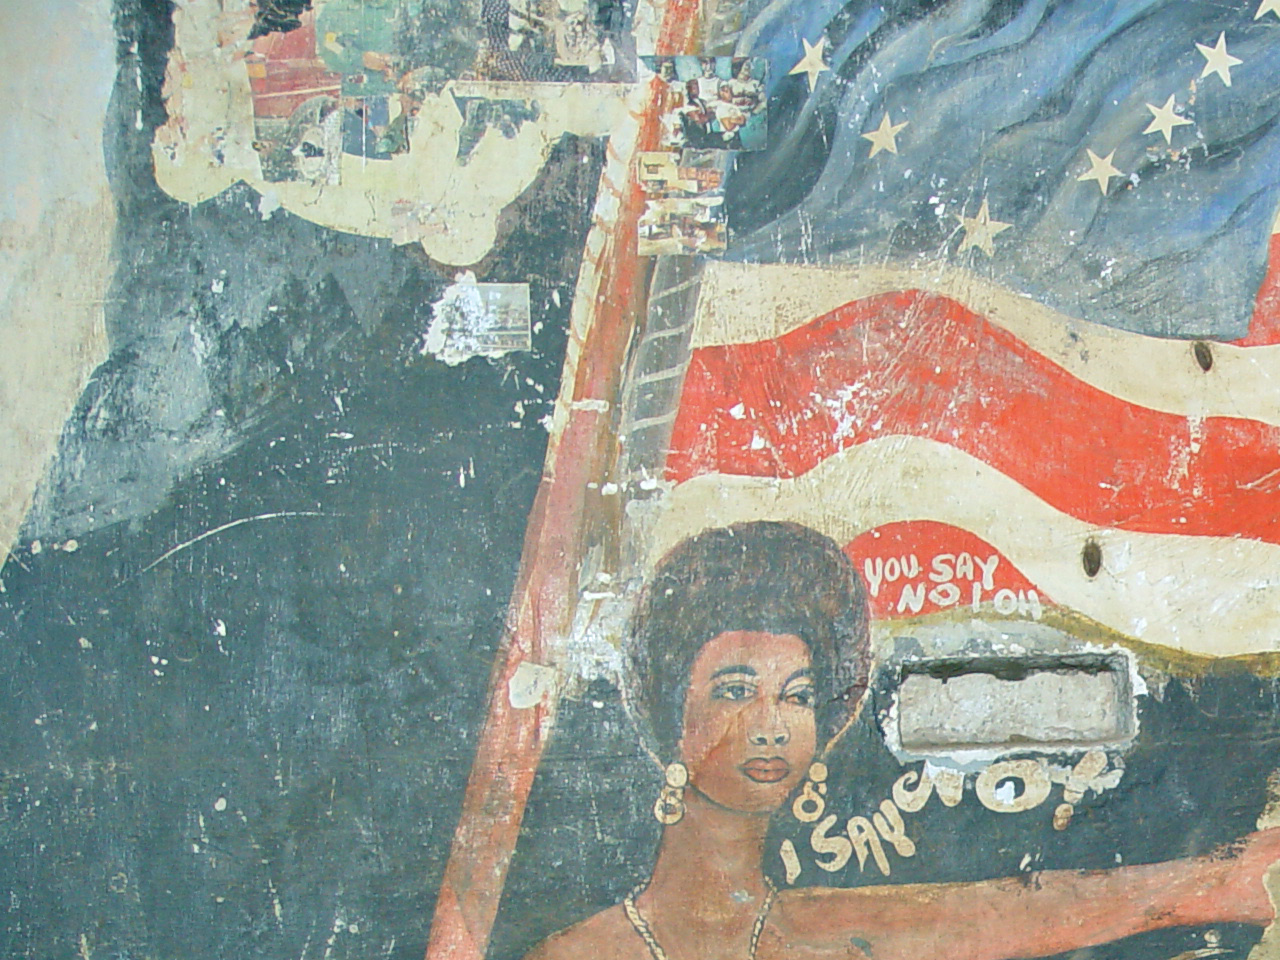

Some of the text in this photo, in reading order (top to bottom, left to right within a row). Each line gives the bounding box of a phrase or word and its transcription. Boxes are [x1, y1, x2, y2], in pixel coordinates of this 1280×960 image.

[864, 552, 999, 598] YOU SAY
[810, 799, 916, 876] SAY
